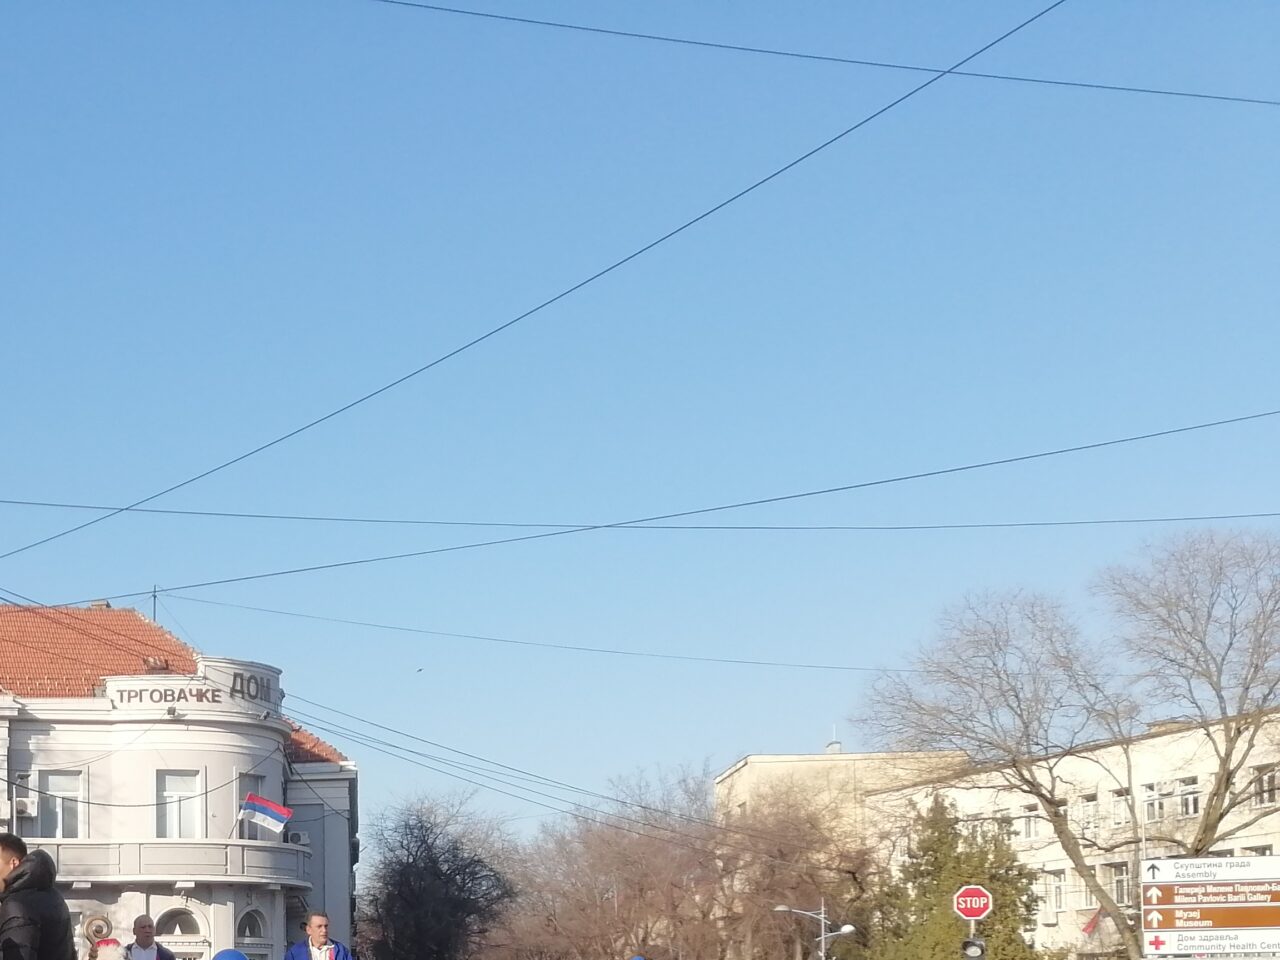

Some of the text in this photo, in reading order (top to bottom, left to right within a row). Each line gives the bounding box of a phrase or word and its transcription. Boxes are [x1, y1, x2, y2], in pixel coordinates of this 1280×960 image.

[230, 672, 270, 701] ДОМ
[1173, 861, 1251, 871] Скупштина града
[1175, 870, 1217, 879] Assembly
[958, 896, 988, 908] STOP
[1174, 894, 1197, 903] Milena
[1247, 893, 1272, 903] Gallery
[1175, 909, 1200, 919] Музеј
[1175, 919, 1213, 928] Museum
[1177, 933, 1239, 942] Дом здравља
[1176, 943, 1227, 952] Community
[1229, 942, 1258, 950] Health
